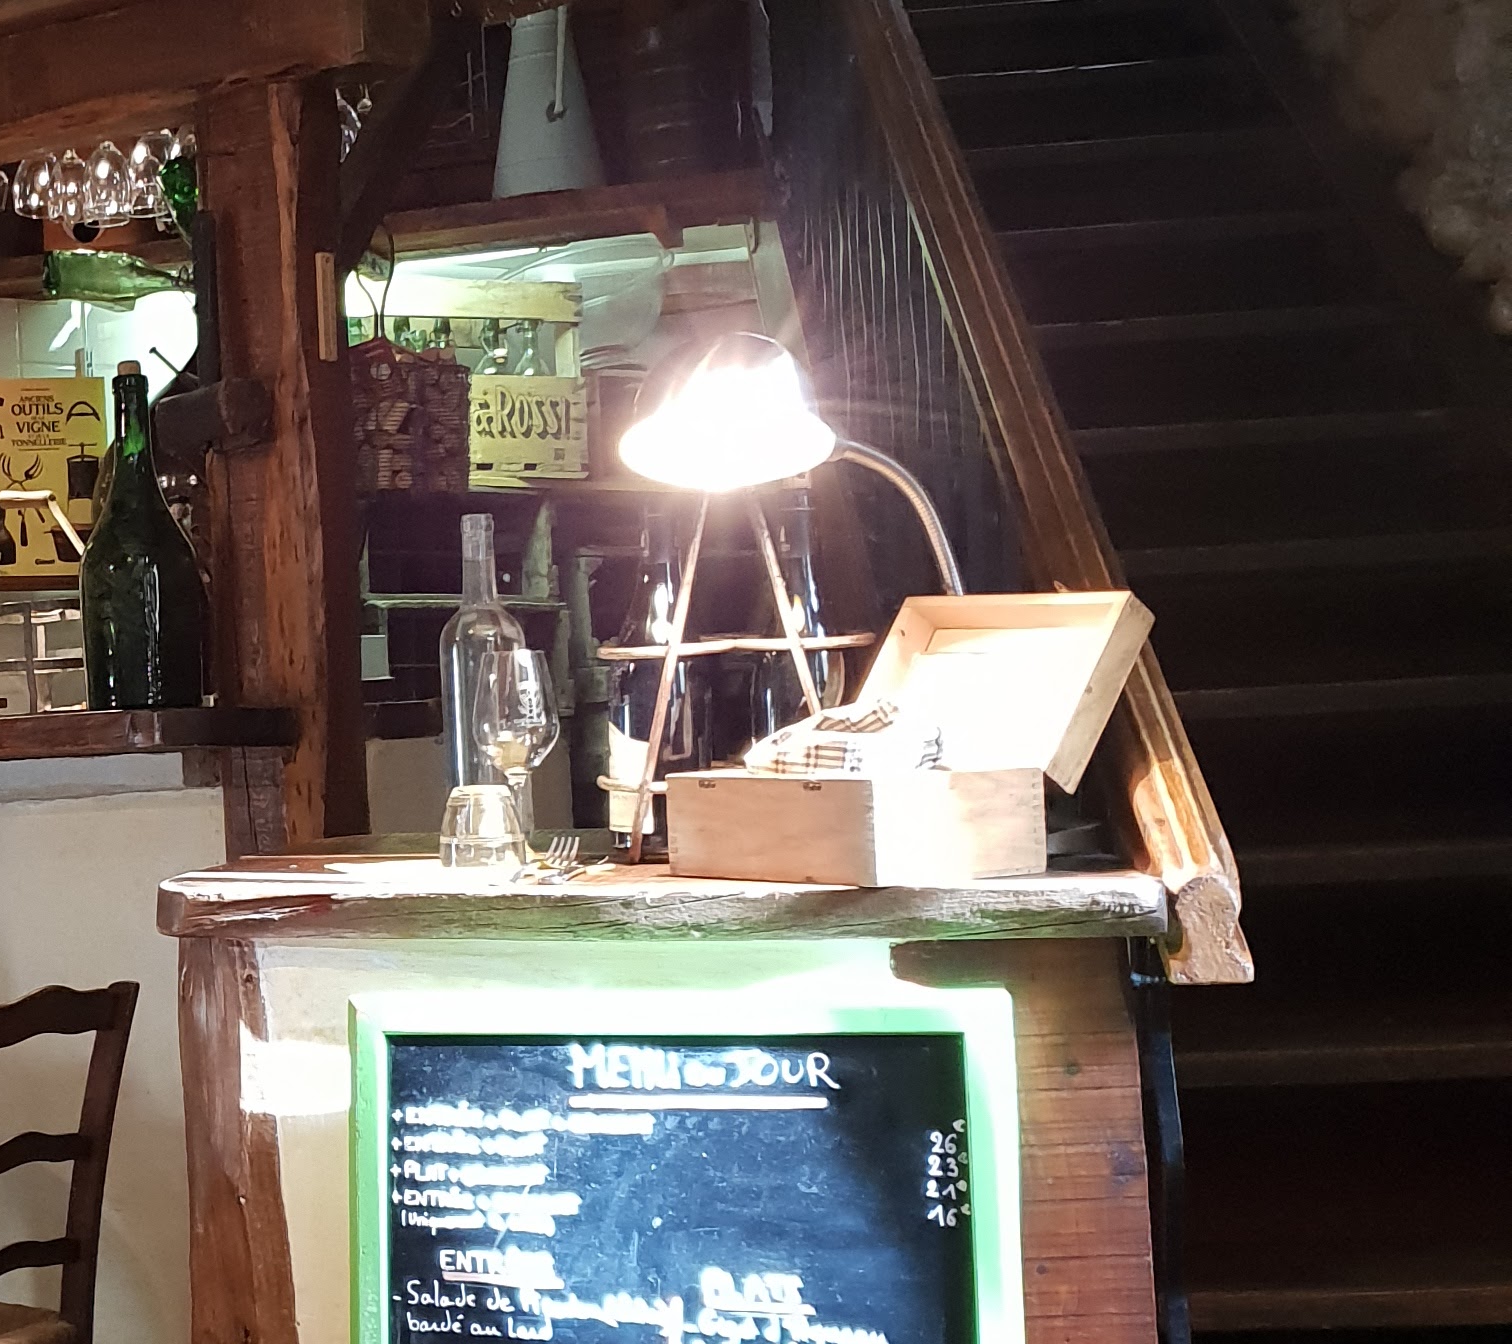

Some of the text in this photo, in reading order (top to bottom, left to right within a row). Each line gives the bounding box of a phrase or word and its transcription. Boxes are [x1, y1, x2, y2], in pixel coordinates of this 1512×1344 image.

[11, 402, 64, 417] OUTILS
[16, 421, 61, 434] VIGNE
[408, 1279, 476, 1309] Salade
[487, 1287, 515, 1313] de
